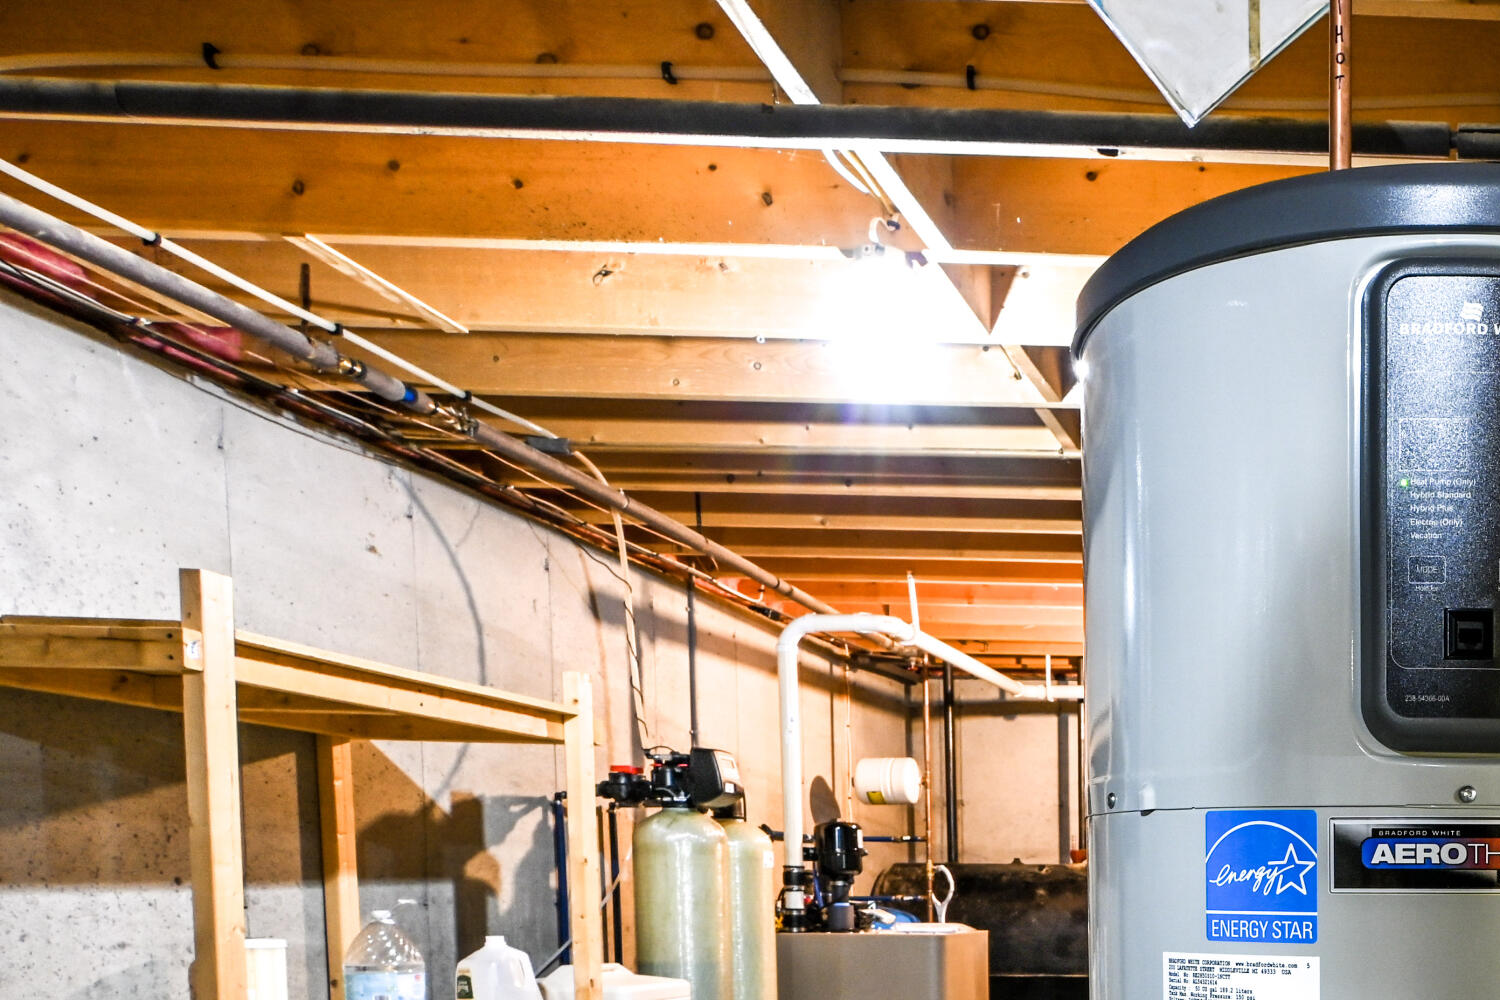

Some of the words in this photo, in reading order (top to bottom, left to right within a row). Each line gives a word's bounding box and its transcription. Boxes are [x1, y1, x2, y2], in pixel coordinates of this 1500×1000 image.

[1335, 24, 1346, 90] HOT
[1400, 322, 1489, 336] BRADFORD
[1209, 864, 1284, 895] energy
[1211, 919, 1269, 939] ENERGY
[1271, 921, 1314, 940] STAR
[1235, 961, 1298, 969] www.bradfordwhite.com
